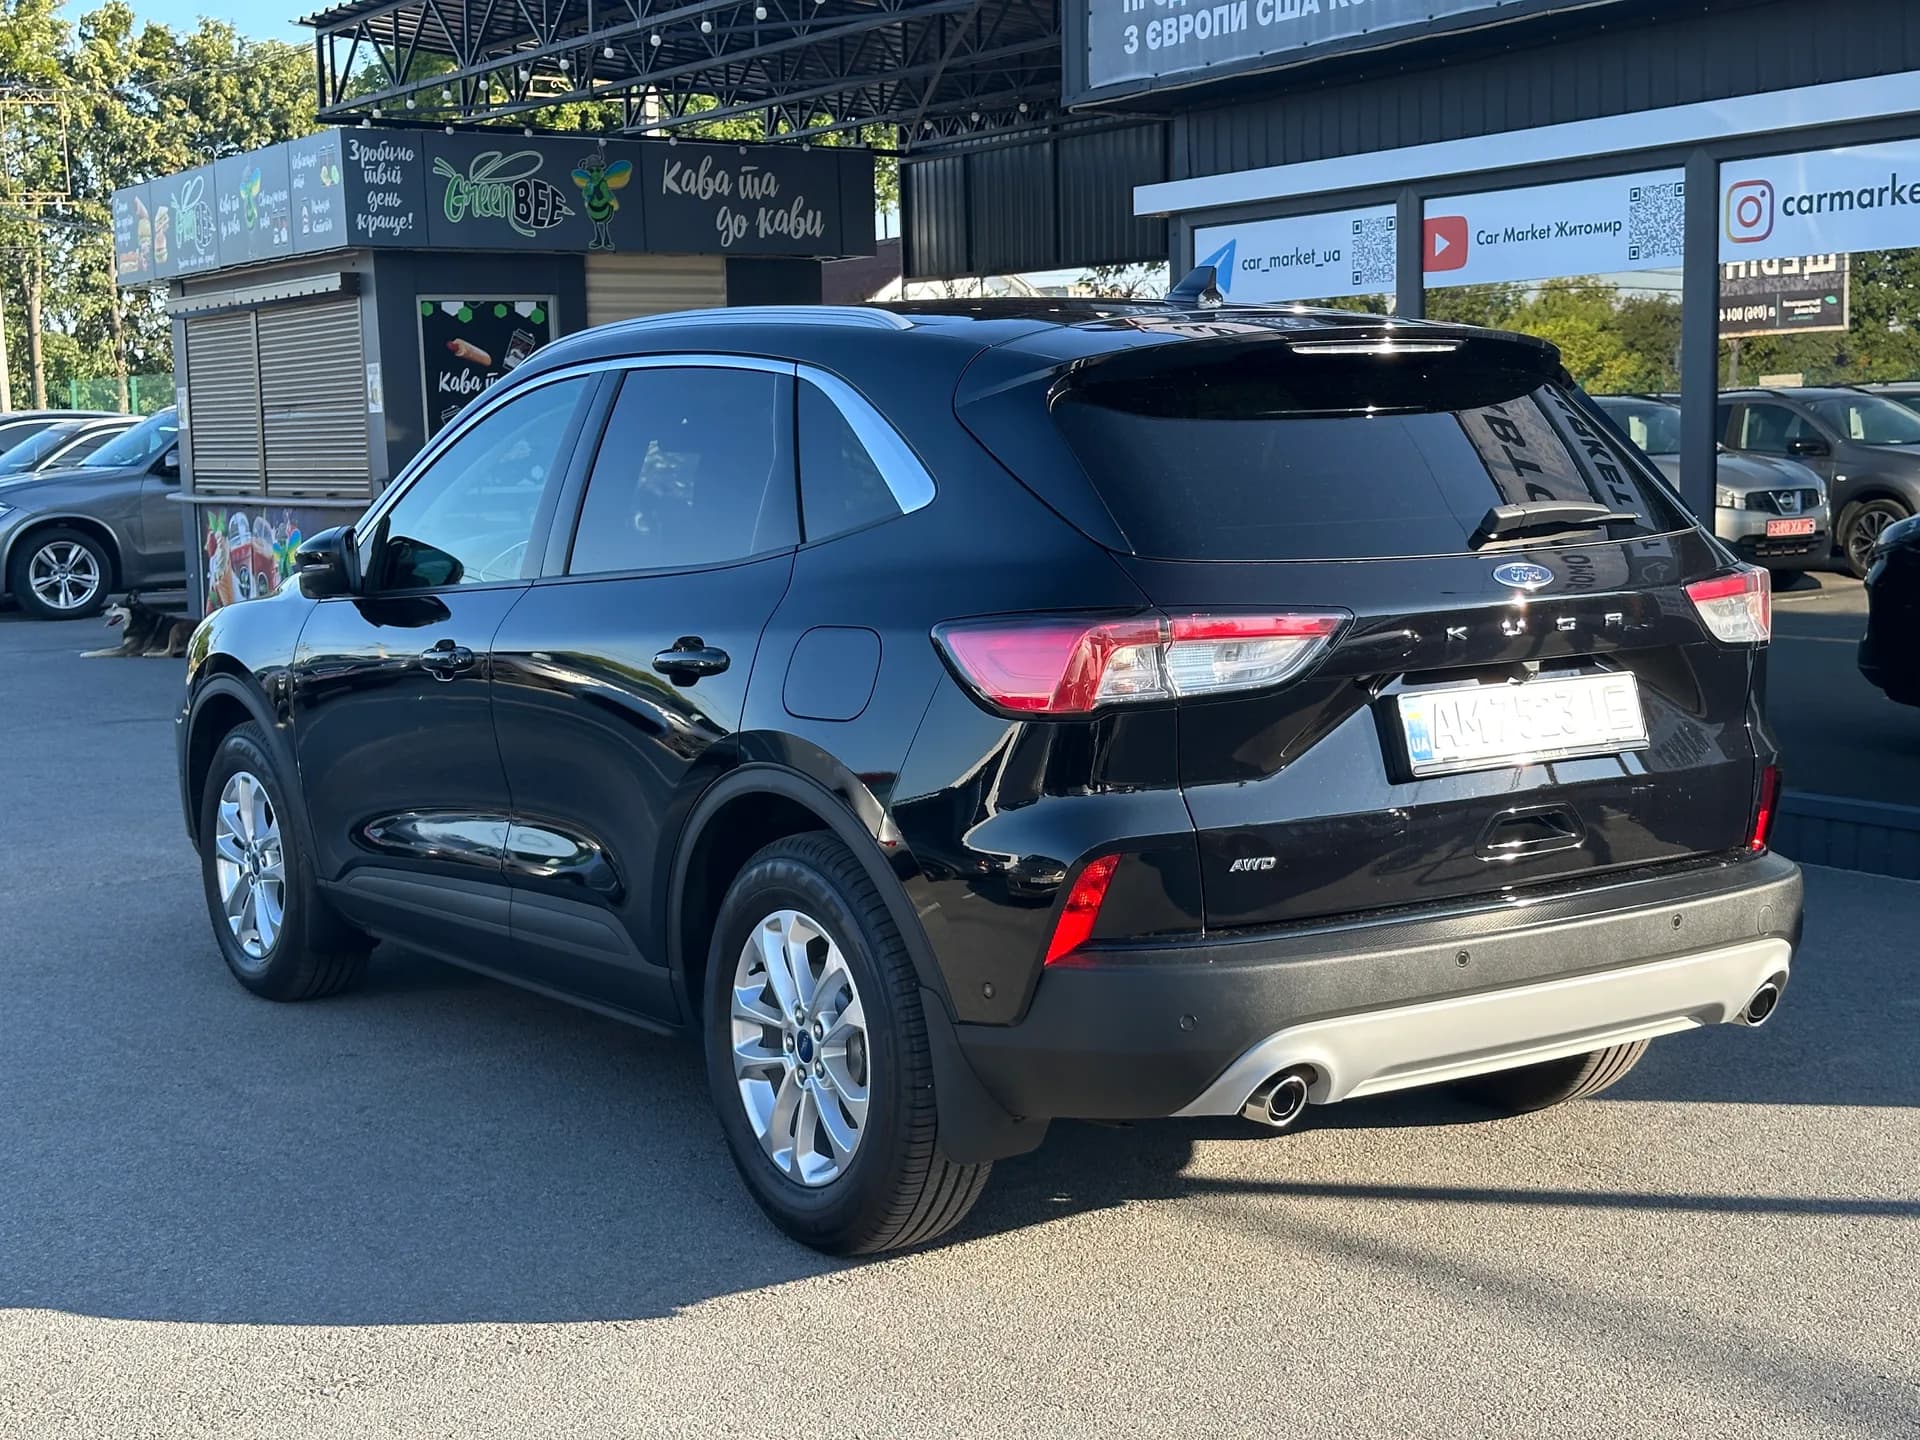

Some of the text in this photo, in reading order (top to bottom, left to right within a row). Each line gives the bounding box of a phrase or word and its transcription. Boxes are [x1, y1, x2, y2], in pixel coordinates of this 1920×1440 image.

[1146, 1, 1248, 50] ЄВРОПИ
[349, 139, 415, 168] Зробимо
[364, 162, 402, 185] твій
[661, 155, 780, 200] Кава та
[367, 190, 402, 213] день
[356, 212, 413, 238] краще!
[715, 195, 826, 247] до кави
[1476, 219, 1622, 246] Car Market Житомир
[1241, 247, 1342, 273] car_market_ua
[439, 367, 482, 395] Кава
[1412, 738, 1430, 753] UA
[1229, 856, 1277, 873] AWD
